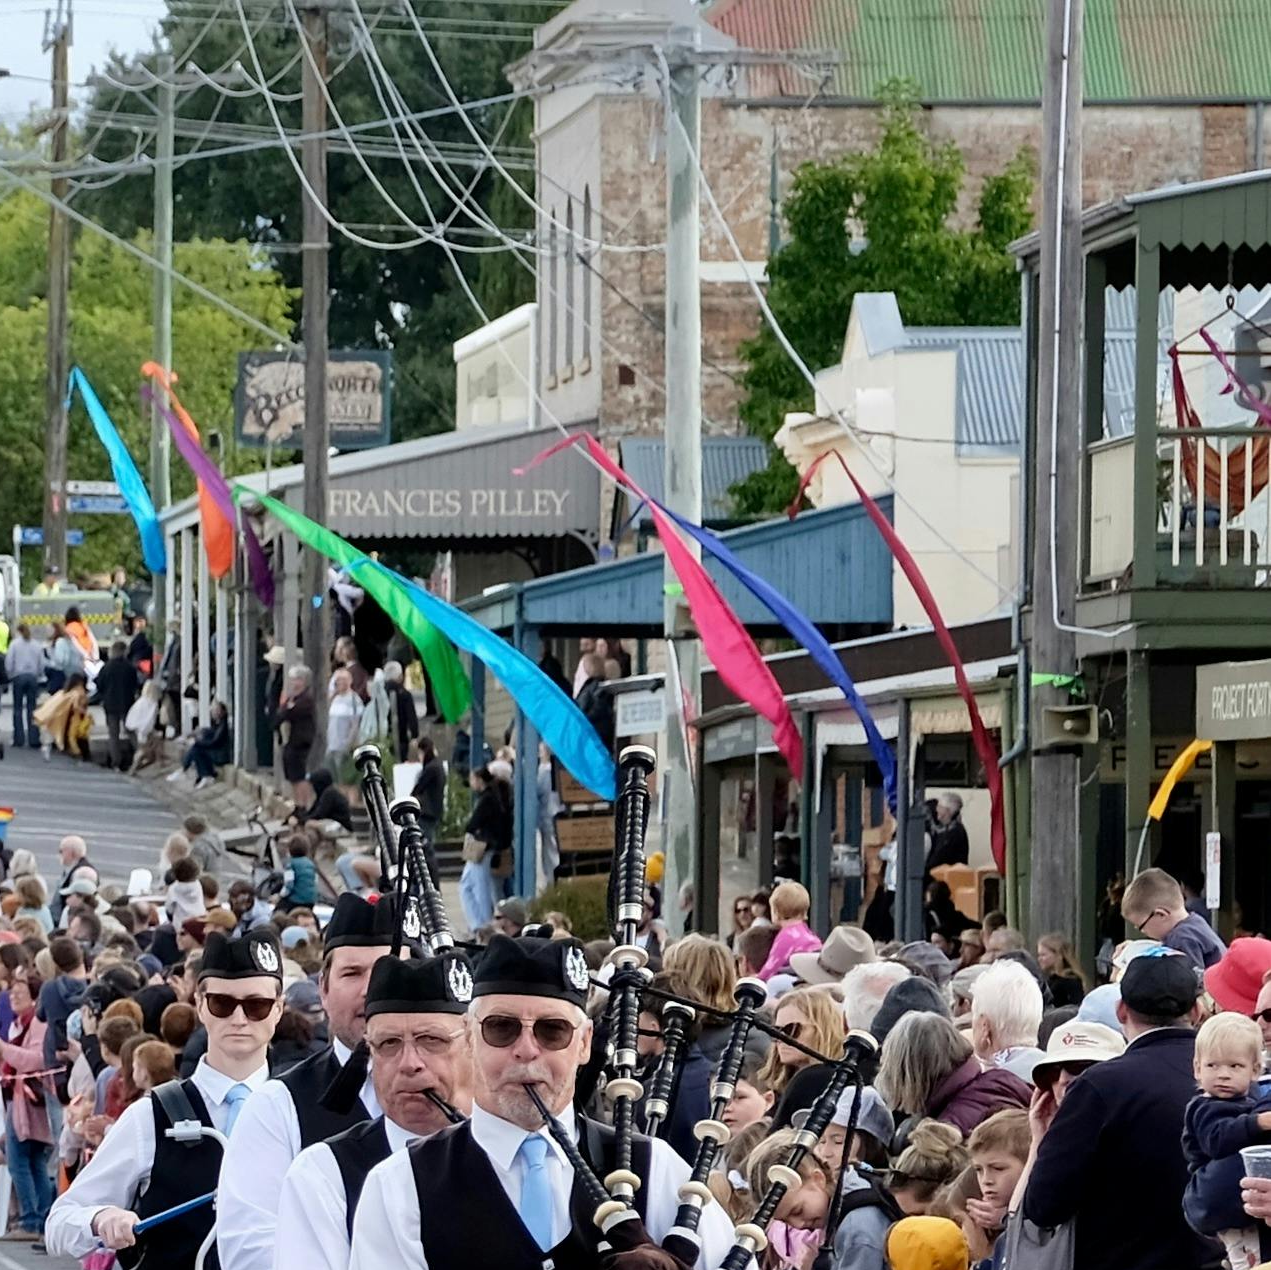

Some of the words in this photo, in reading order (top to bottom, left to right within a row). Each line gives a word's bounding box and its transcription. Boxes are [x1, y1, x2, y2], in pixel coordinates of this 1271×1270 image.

[328, 488, 462, 517] FRANCES
[469, 488, 570, 517] PILLEY
[1211, 684, 1246, 721] PROJECT
